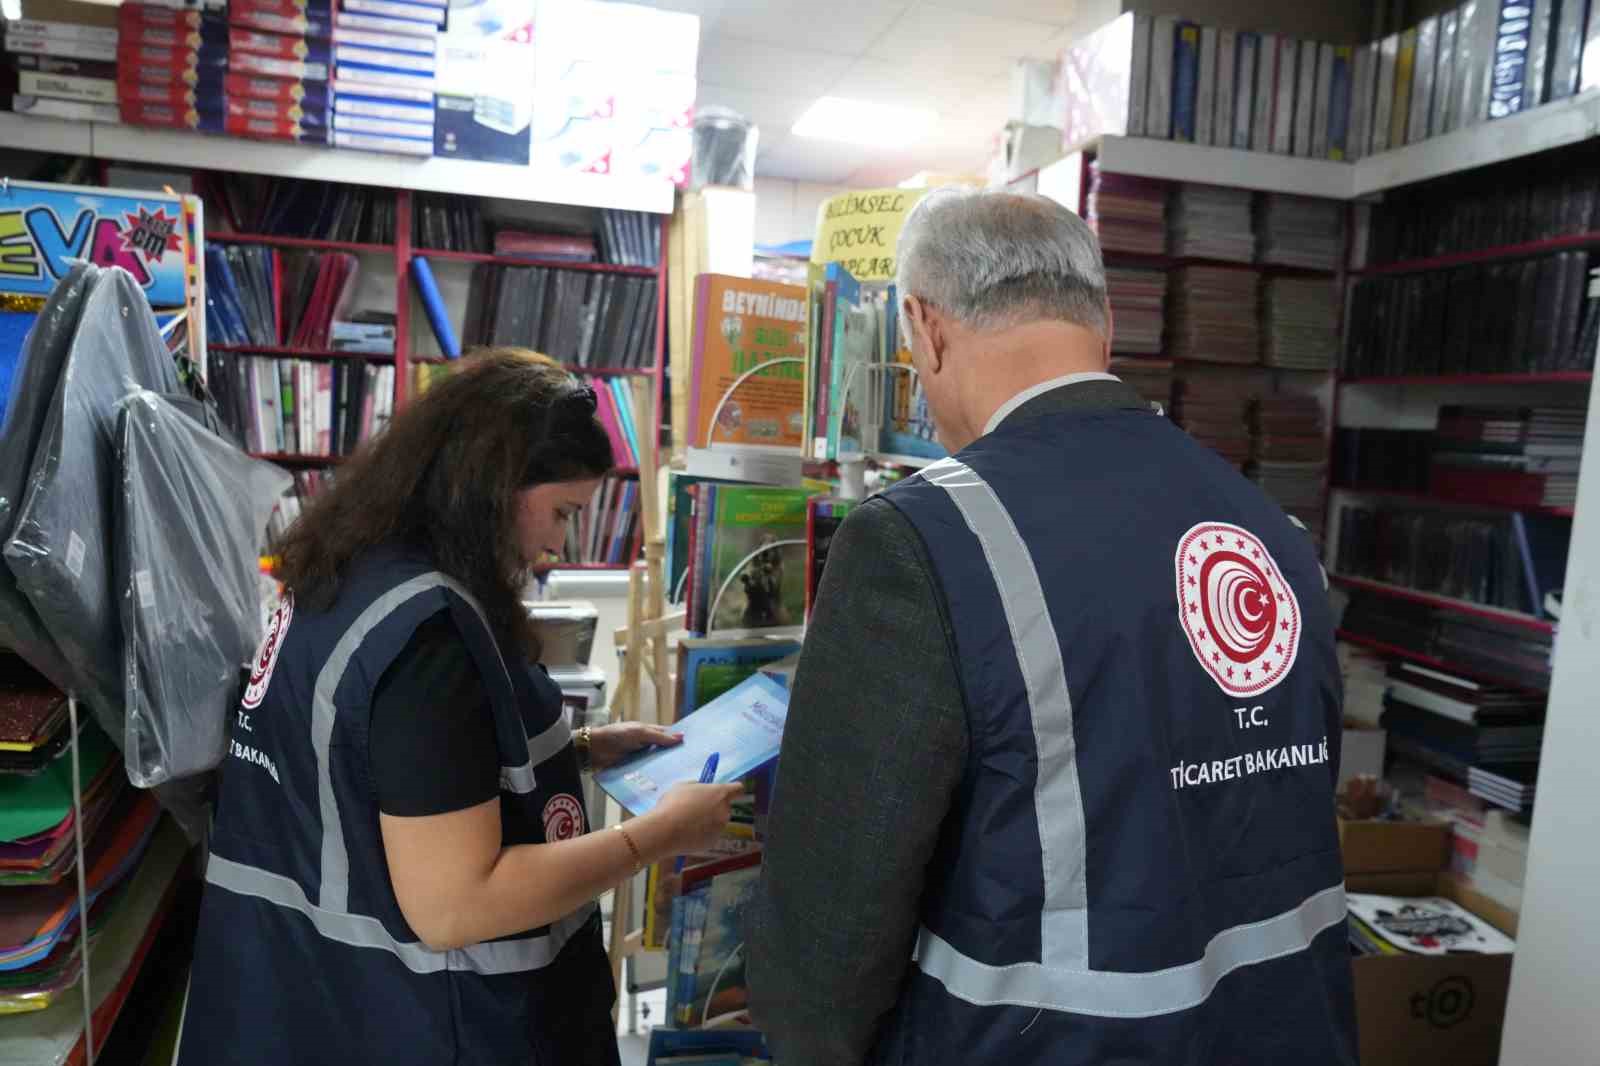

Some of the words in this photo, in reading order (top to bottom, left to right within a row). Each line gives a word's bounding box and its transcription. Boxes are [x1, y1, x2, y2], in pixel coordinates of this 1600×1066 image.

[0, 207, 152, 285] EVA
[237, 710, 252, 732] T.C.
[1234, 706, 1268, 729] T.C.
[1170, 760, 1243, 790] TİCARET
